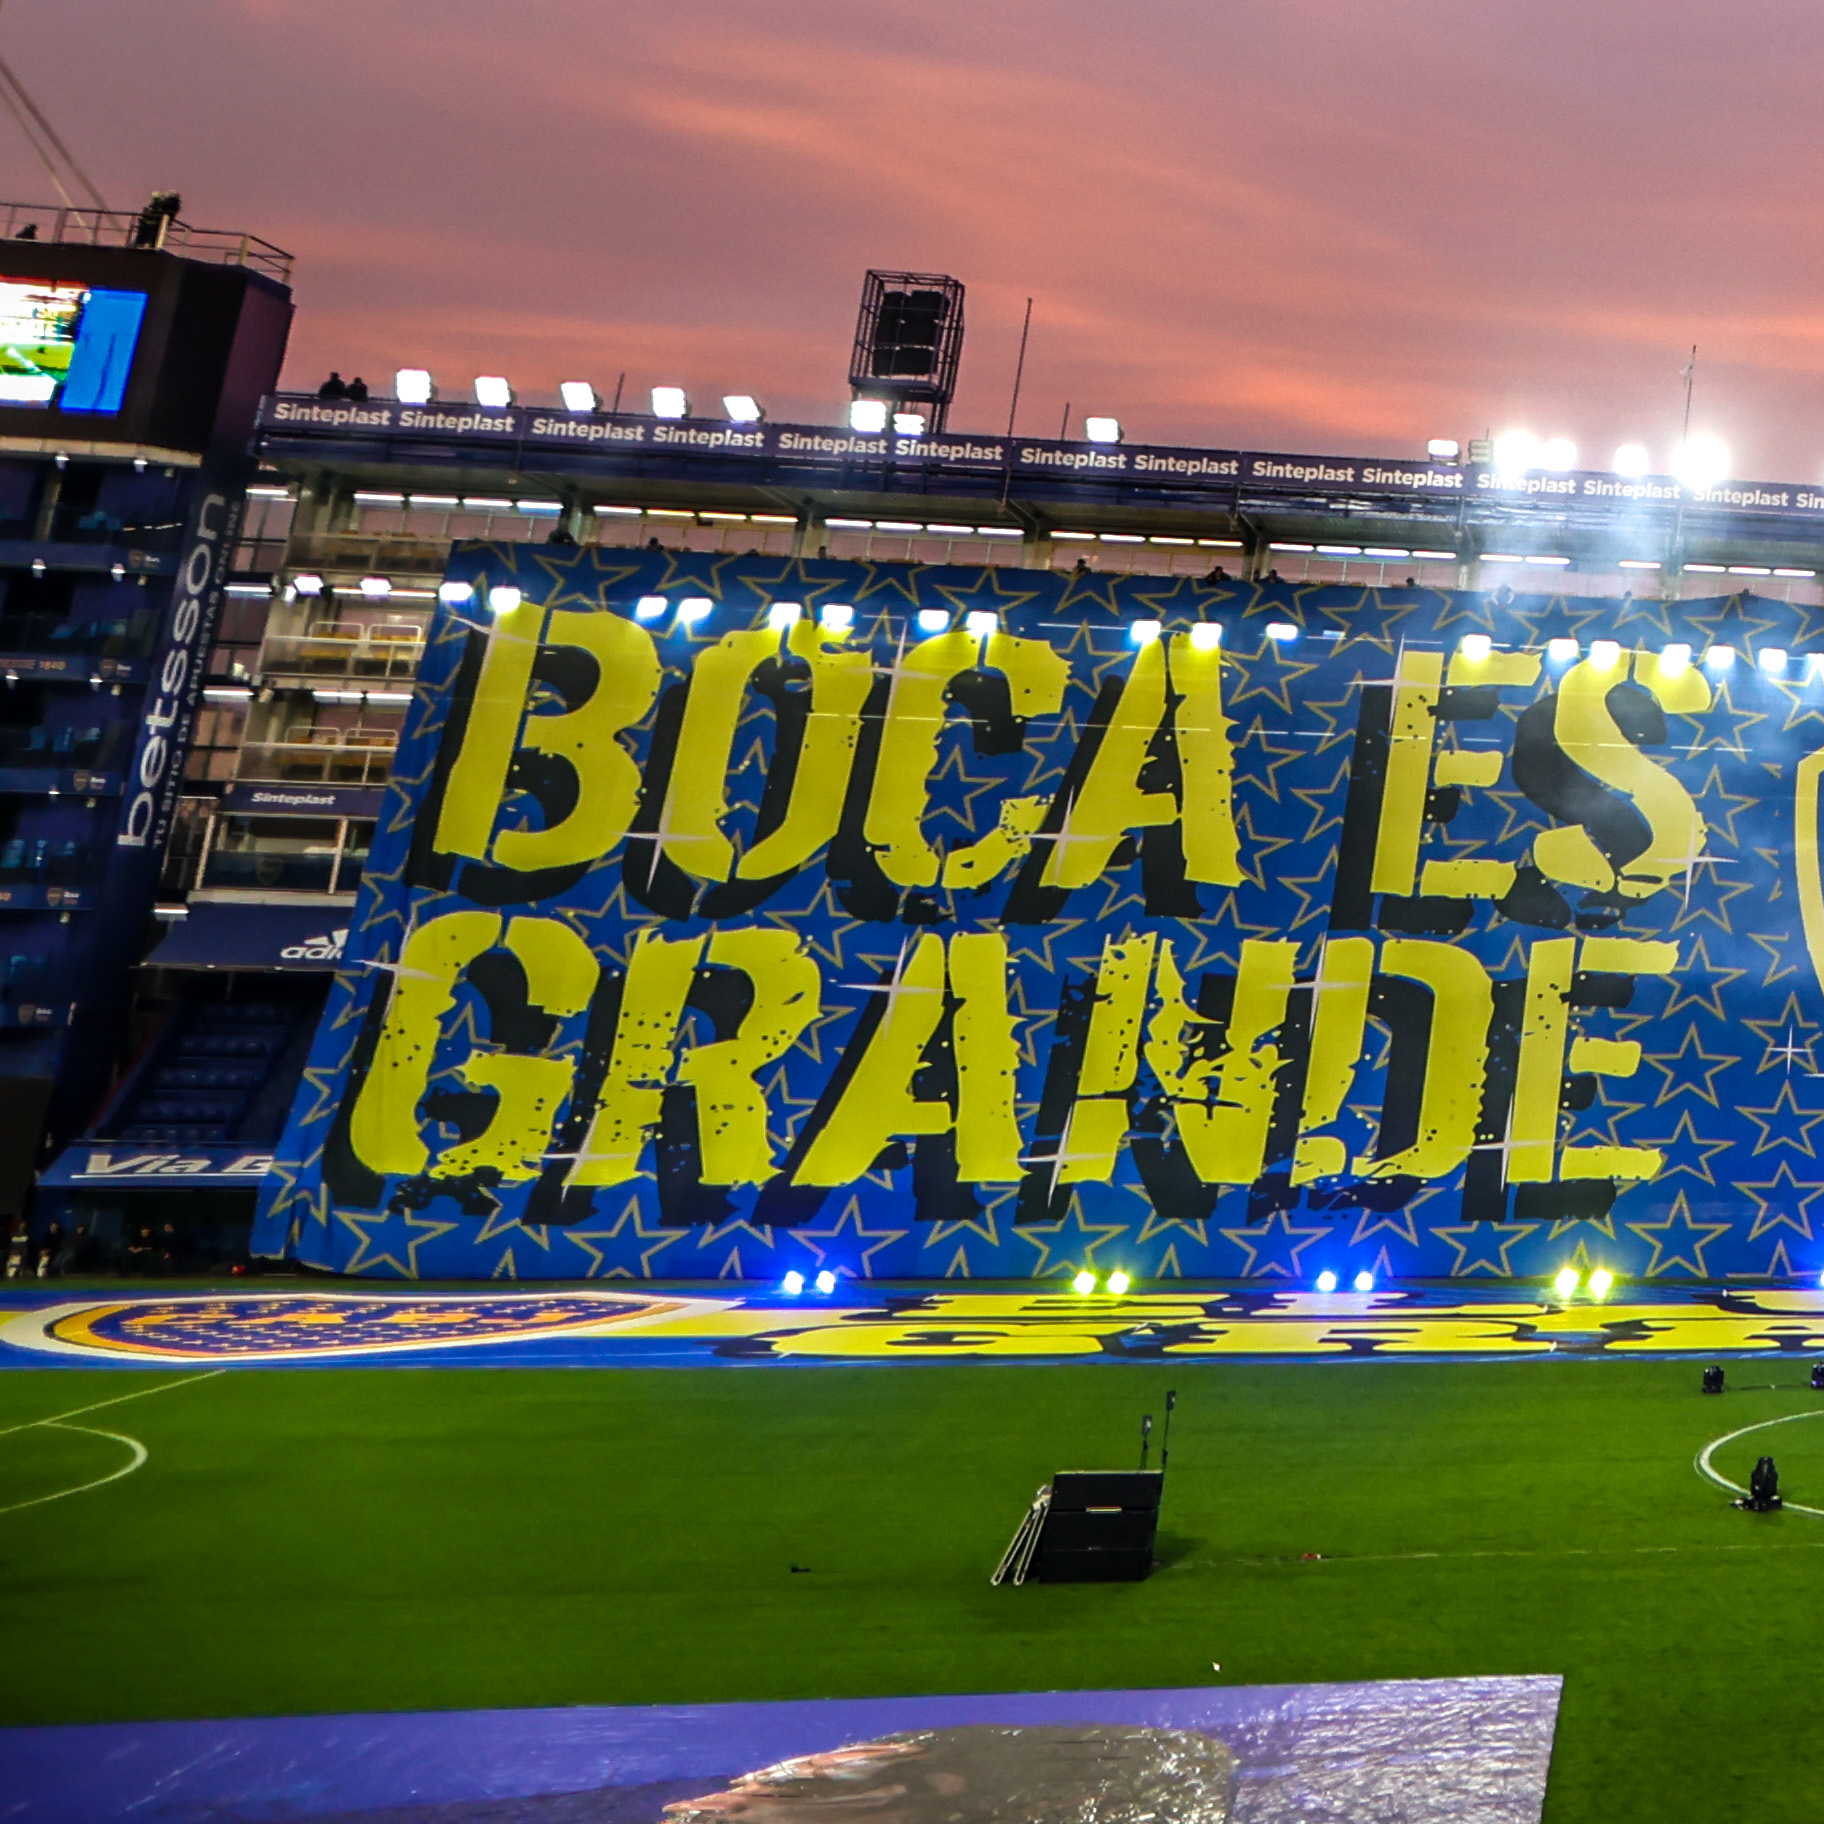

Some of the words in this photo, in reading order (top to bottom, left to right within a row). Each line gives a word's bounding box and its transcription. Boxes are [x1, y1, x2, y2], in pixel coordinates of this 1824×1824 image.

[274, 403, 391, 426] Sinteplast
[399, 410, 515, 433] Sinteplast
[532, 418, 644, 442] Sinteplast
[653, 425, 765, 449] Sinteplast
[779, 432, 887, 456] Sinteplast
[895, 439, 1003, 461] Sinteplast
[1021, 447, 1127, 470] Sinteplast
[1134, 454, 1239, 477] Sinteplast
[1252, 461, 1354, 484] Sinteplast
[1362, 467, 1463, 489] Sinteplast
[1477, 473, 1576, 496] Sinteplast
[1583, 479, 1681, 501] Sinteplast
[1694, 485, 1789, 508] Sinteplast
[117, 493, 226, 847] betsson
[251, 791, 336, 807] Sinteplast
[433, 601, 1245, 890] BOCA
[1373, 640, 1713, 902] ES
[347, 911, 1679, 1188] GRANDE
[84, 1154, 211, 1174] Via
[890, 1290, 1551, 1317] EL
